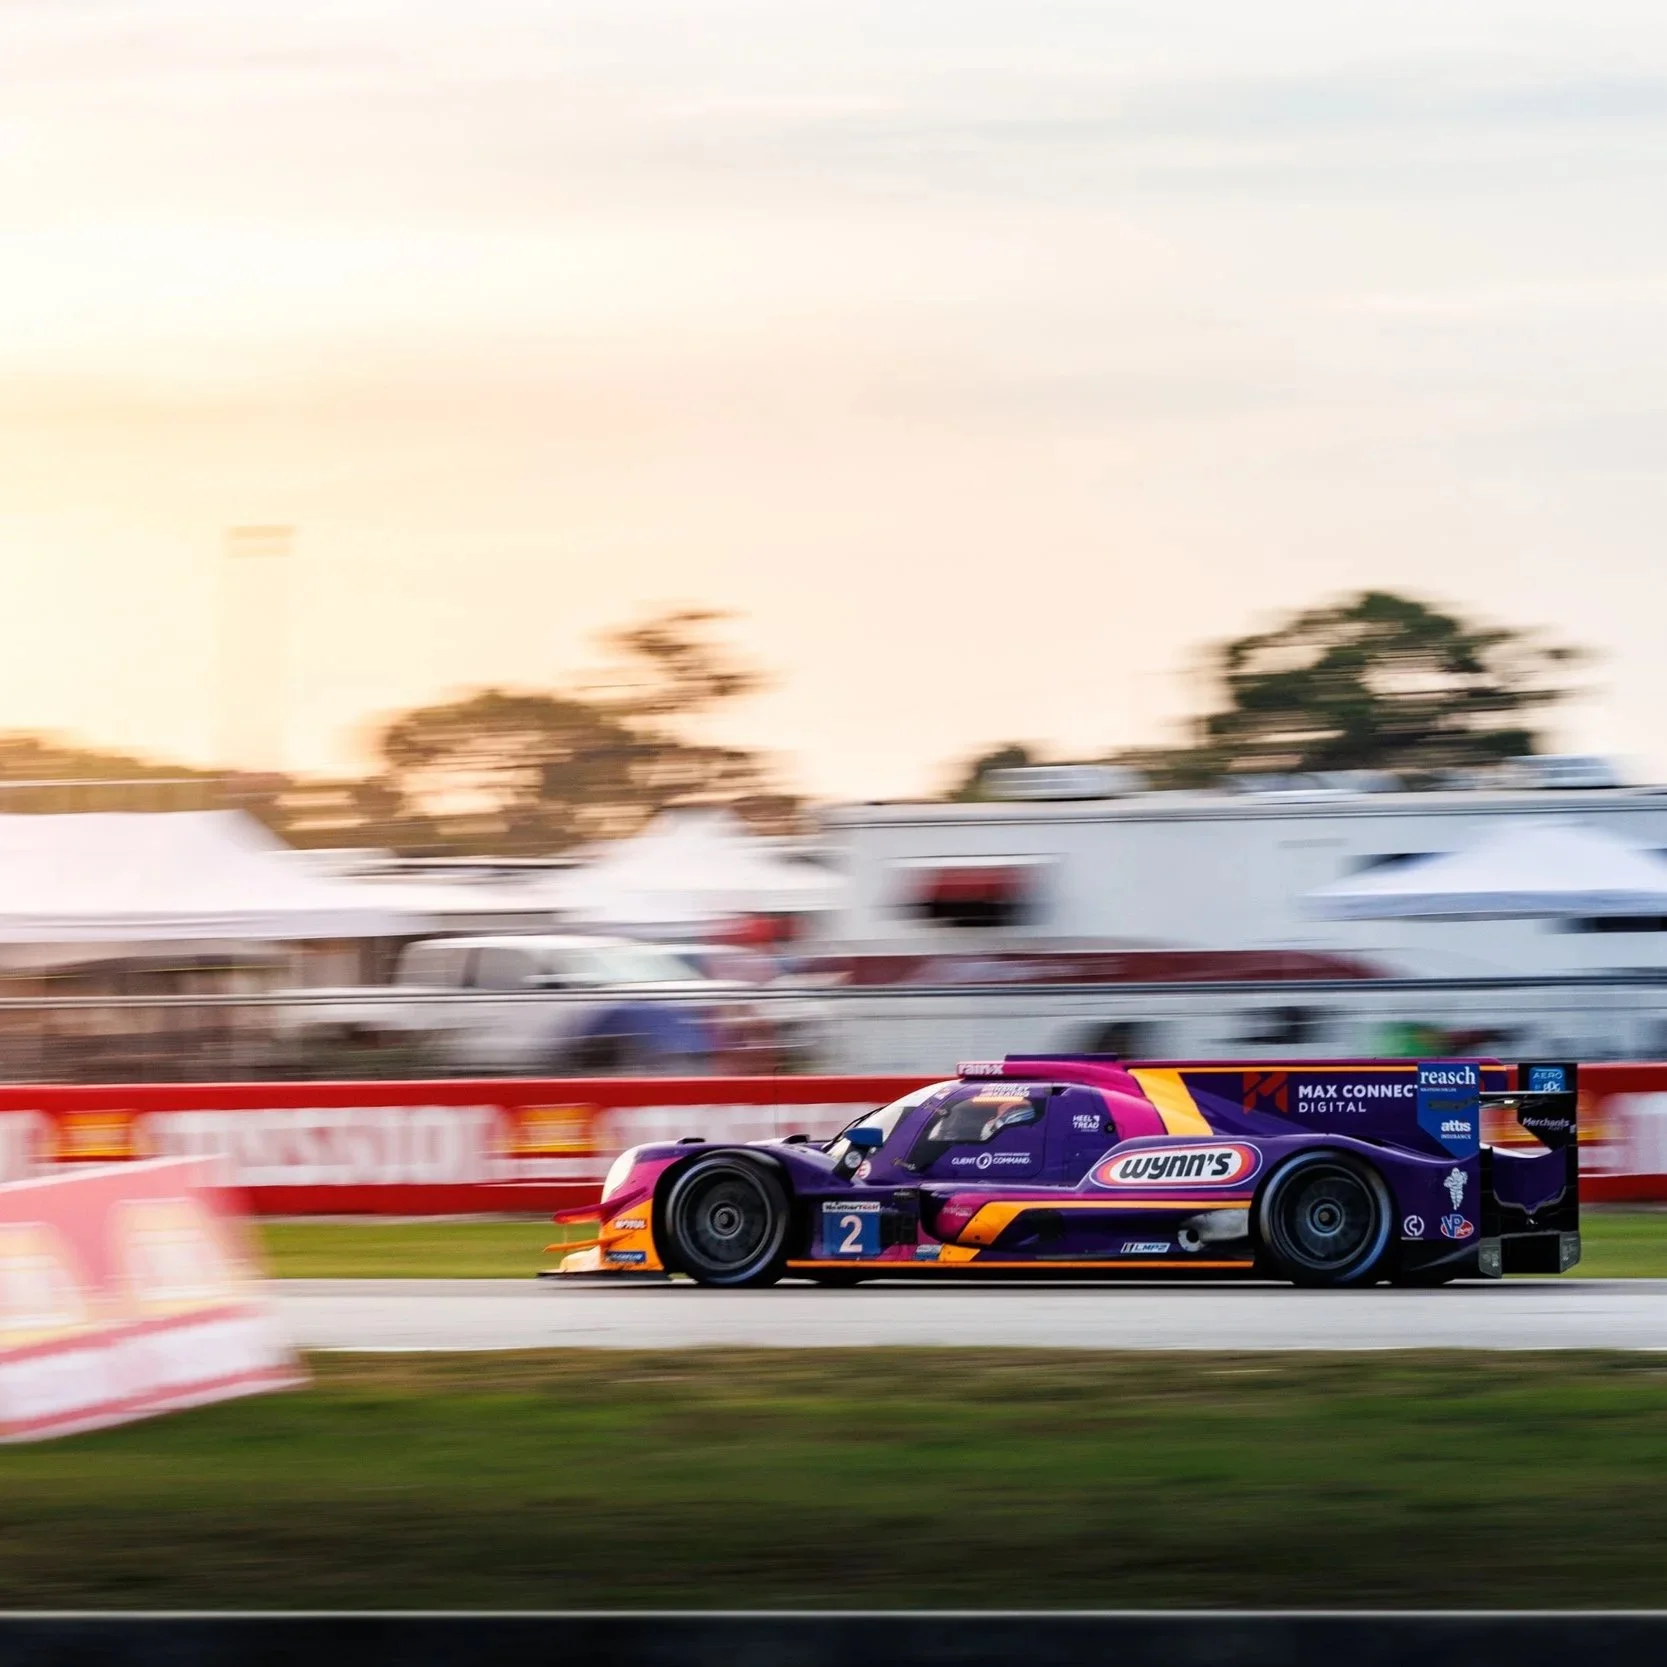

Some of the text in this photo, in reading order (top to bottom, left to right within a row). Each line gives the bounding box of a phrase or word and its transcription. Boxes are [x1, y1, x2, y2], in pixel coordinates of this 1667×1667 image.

[1420, 1066, 1476, 1085] reasch
[1298, 1084, 1338, 1099] MAX
[1298, 1102, 1366, 1113] DIGITAL
[1523, 1117, 1570, 1127] Merchants
[993, 1157, 1031, 1165] COMMAND
[839, 1214, 862, 1253] 2
[1441, 1214, 1464, 1238] VP
